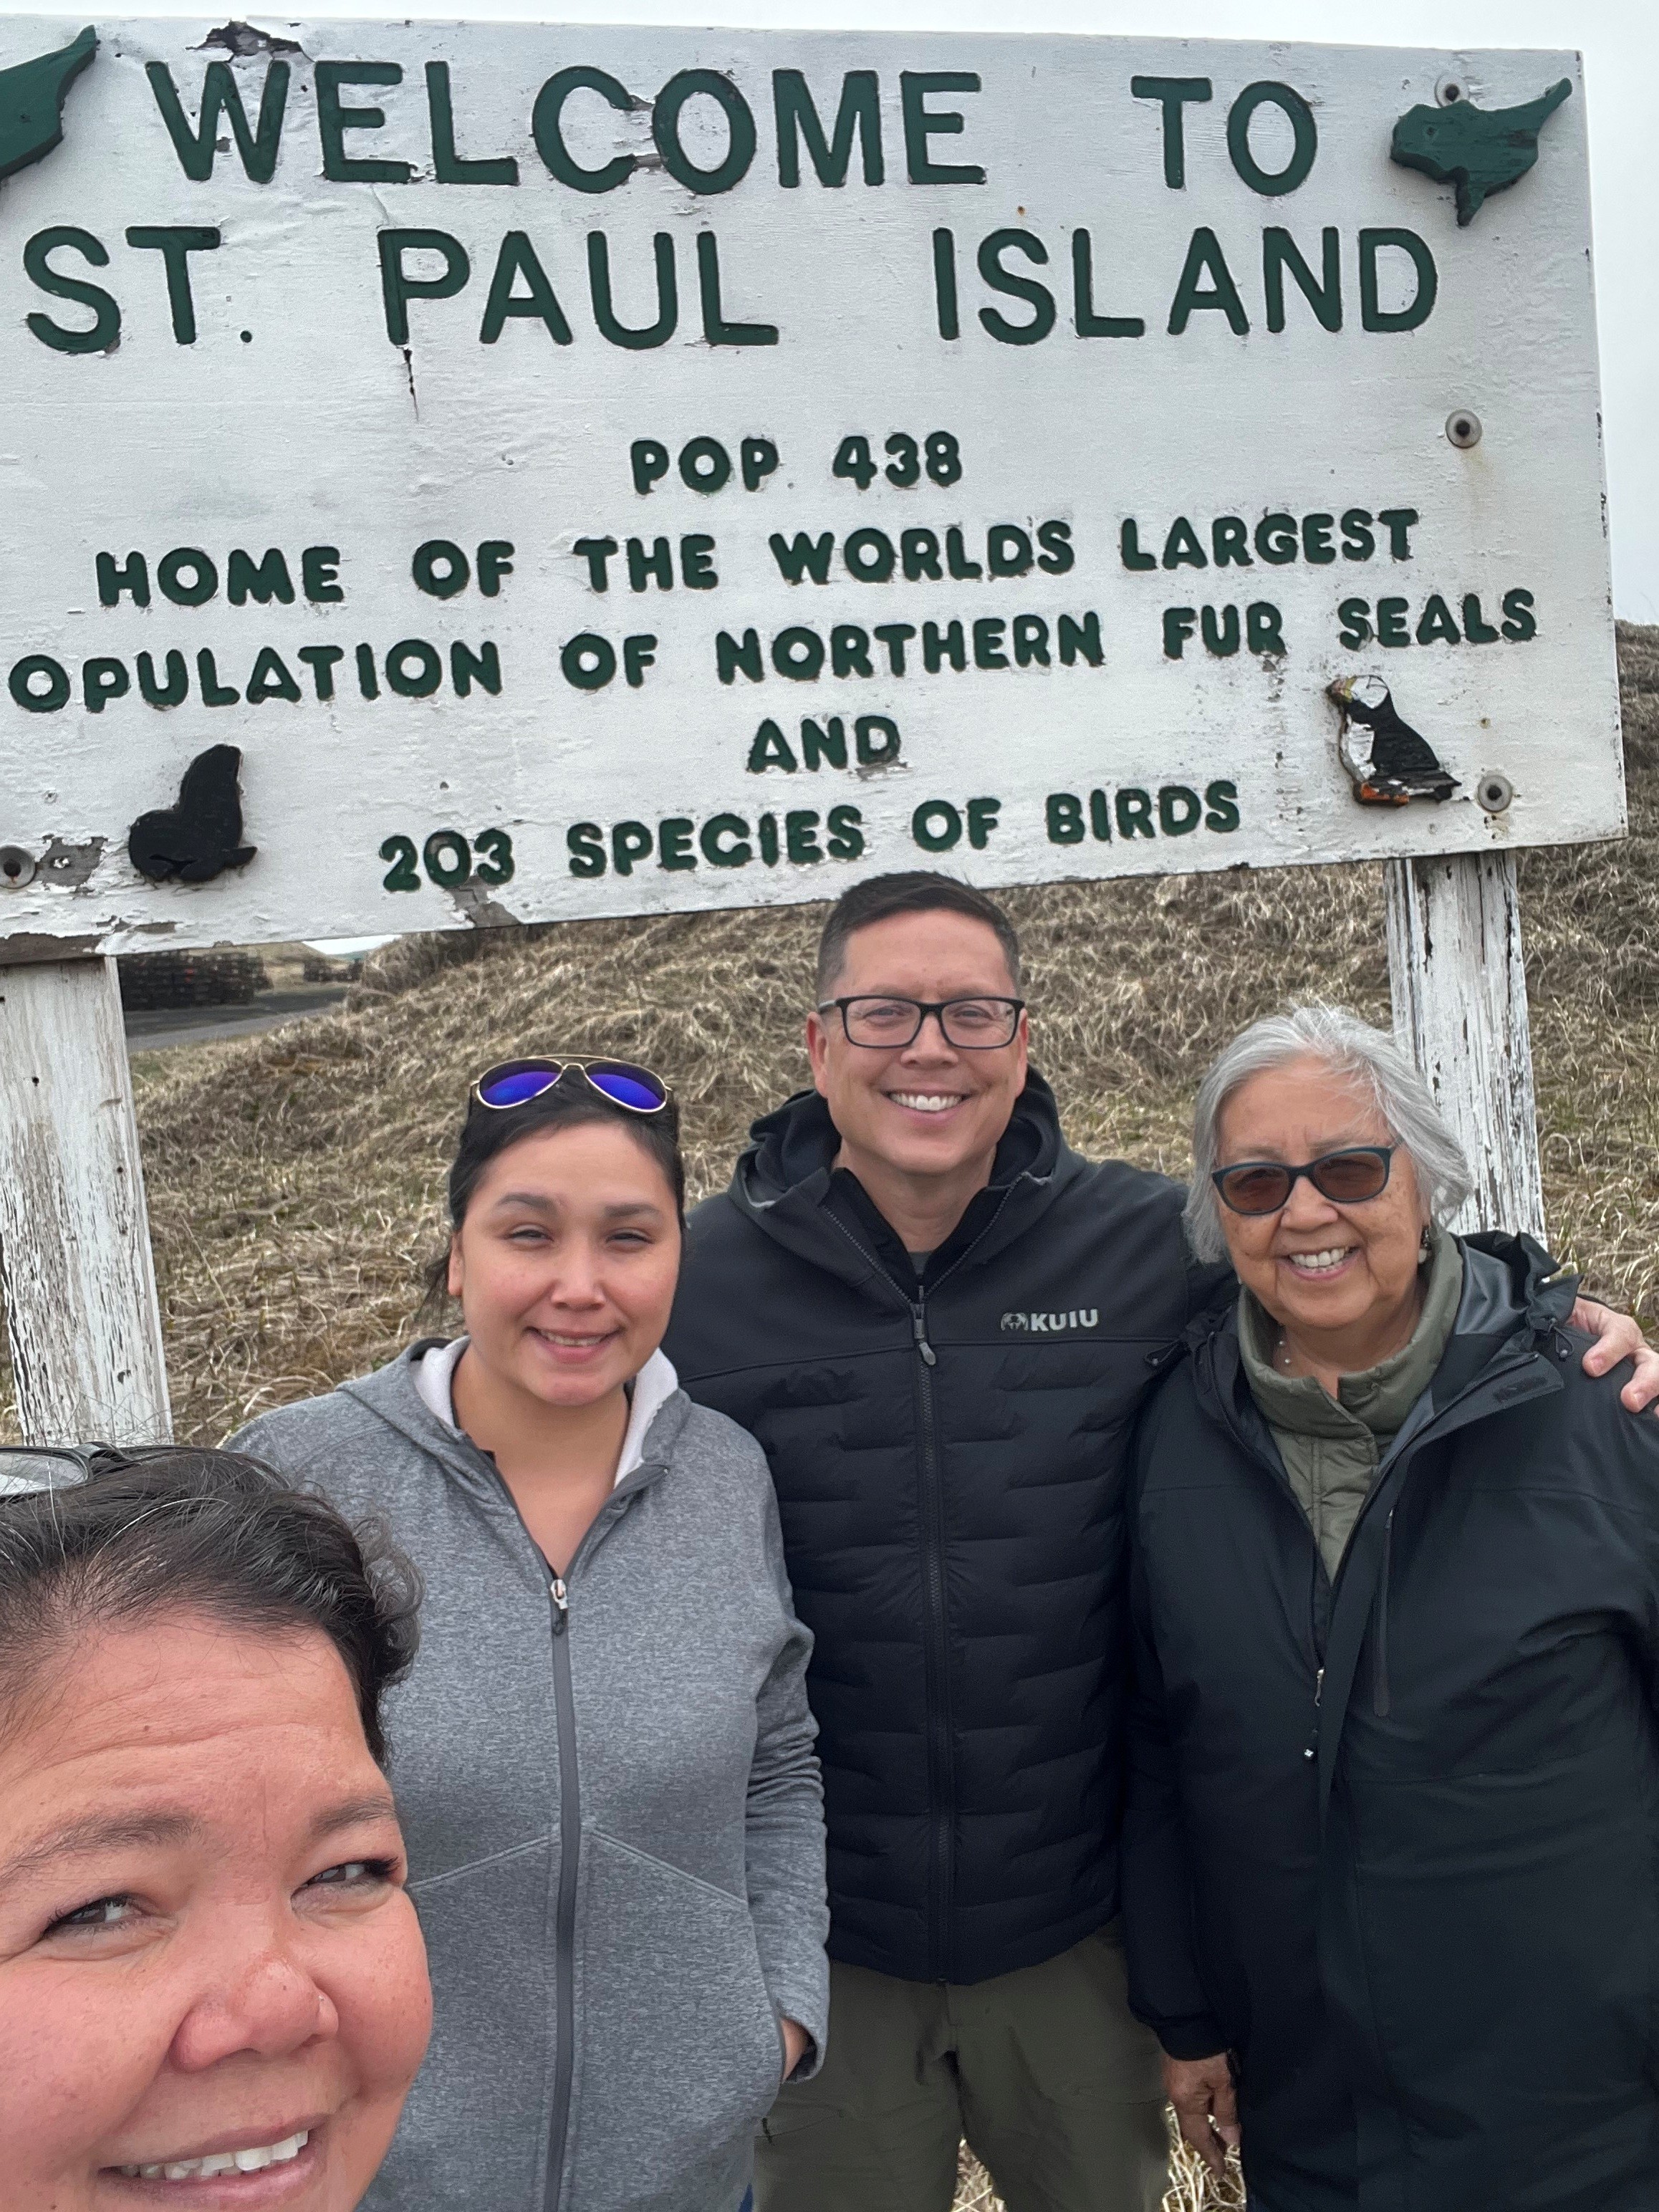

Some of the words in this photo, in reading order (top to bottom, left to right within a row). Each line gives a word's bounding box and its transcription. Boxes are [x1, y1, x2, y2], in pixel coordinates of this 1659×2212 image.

[146, 60, 985, 195] WELCOME
[1130, 75, 1319, 197] TO
[23, 226, 253, 354] ST.
[378, 229, 779, 350] PAUL
[933, 227, 1438, 345] ISLAND
[630, 437, 779, 496] POP
[832, 431, 962, 489] 438
[95, 546, 344, 607] HOME
[411, 539, 514, 598] OF
[573, 533, 718, 592] THE
[769, 519, 1075, 584] WORLDS
[1120, 509, 1418, 571] LARGEST
[560, 633, 658, 690] OF
[716, 610, 1104, 684] NORTHERN
[1162, 601, 1285, 658] FUR
[1338, 588, 1538, 650] SEALS
[748, 715, 900, 774] AND
[380, 830, 514, 893] 203
[567, 804, 865, 878] SPECIES
[911, 797, 1002, 853] OF
[1046, 779, 1241, 845] BIRDS
[1030, 1308, 1098, 1332] KUIU
